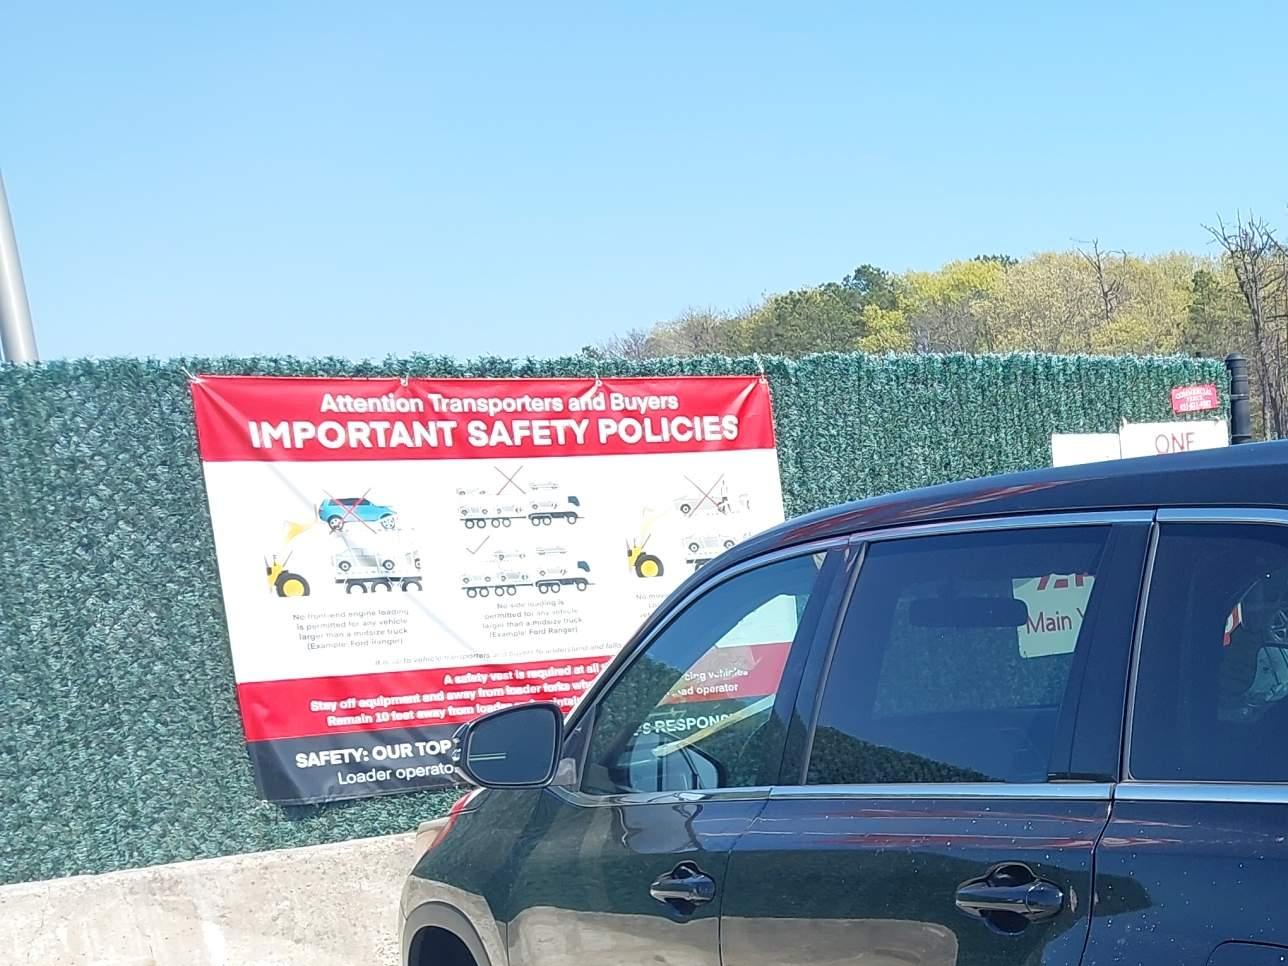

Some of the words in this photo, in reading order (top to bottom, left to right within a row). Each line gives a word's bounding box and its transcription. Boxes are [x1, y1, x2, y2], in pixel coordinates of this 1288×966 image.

[320, 393, 423, 413] Attention
[428, 393, 563, 416] Transporters
[568, 392, 606, 412] and
[609, 392, 679, 414] Buyers
[248, 420, 457, 449] IMPORTANT
[467, 418, 589, 448] SAFETY
[598, 414, 739, 444] POLICIES
[348, 610, 376, 618] engine
[378, 608, 409, 616] loading
[484, 611, 522, 620] permitted
[532, 618, 561, 626] midsize
[563, 616, 582, 624] truck
[306, 622, 346, 631] permitted
[379, 617, 408, 625] vehicle
[528, 627, 546, 635] Ford
[548, 626, 578, 635] Ranger)
[1026, 611, 1073, 634] Main
[299, 633, 324, 641] larger
[354, 629, 385, 637] midsize
[387, 627, 408, 635] truck
[350, 639, 369, 647] Ford
[444, 674, 454, 685] A
[455, 672, 488, 685] safety
[489, 670, 513, 682] vest
[515, 669, 525, 679] is
[527, 665, 572, 680] required
[573, 664, 584, 674] at
[586, 662, 599, 674] all
[310, 700, 337, 713] Stay
[340, 697, 356, 710] off
[358, 693, 420, 709] equipment
[422, 690, 445, 703] and
[447, 690, 476, 701] away
[478, 687, 504, 698] from
[506, 684, 541, 696] loader
[543, 681, 570, 693] forks
[696, 683, 739, 696] operator
[327, 713, 373, 727] Remain
[375, 711, 390, 723] 10
[391, 710, 415, 721] feet
[416, 708, 446, 719] away
[447, 705, 475, 716] from
[295, 747, 370, 769] SAFETY:
[371, 744, 413, 761] OUR
[414, 739, 452, 755] TOP
[337, 767, 393, 785] Loader
[395, 763, 454, 781] operato
